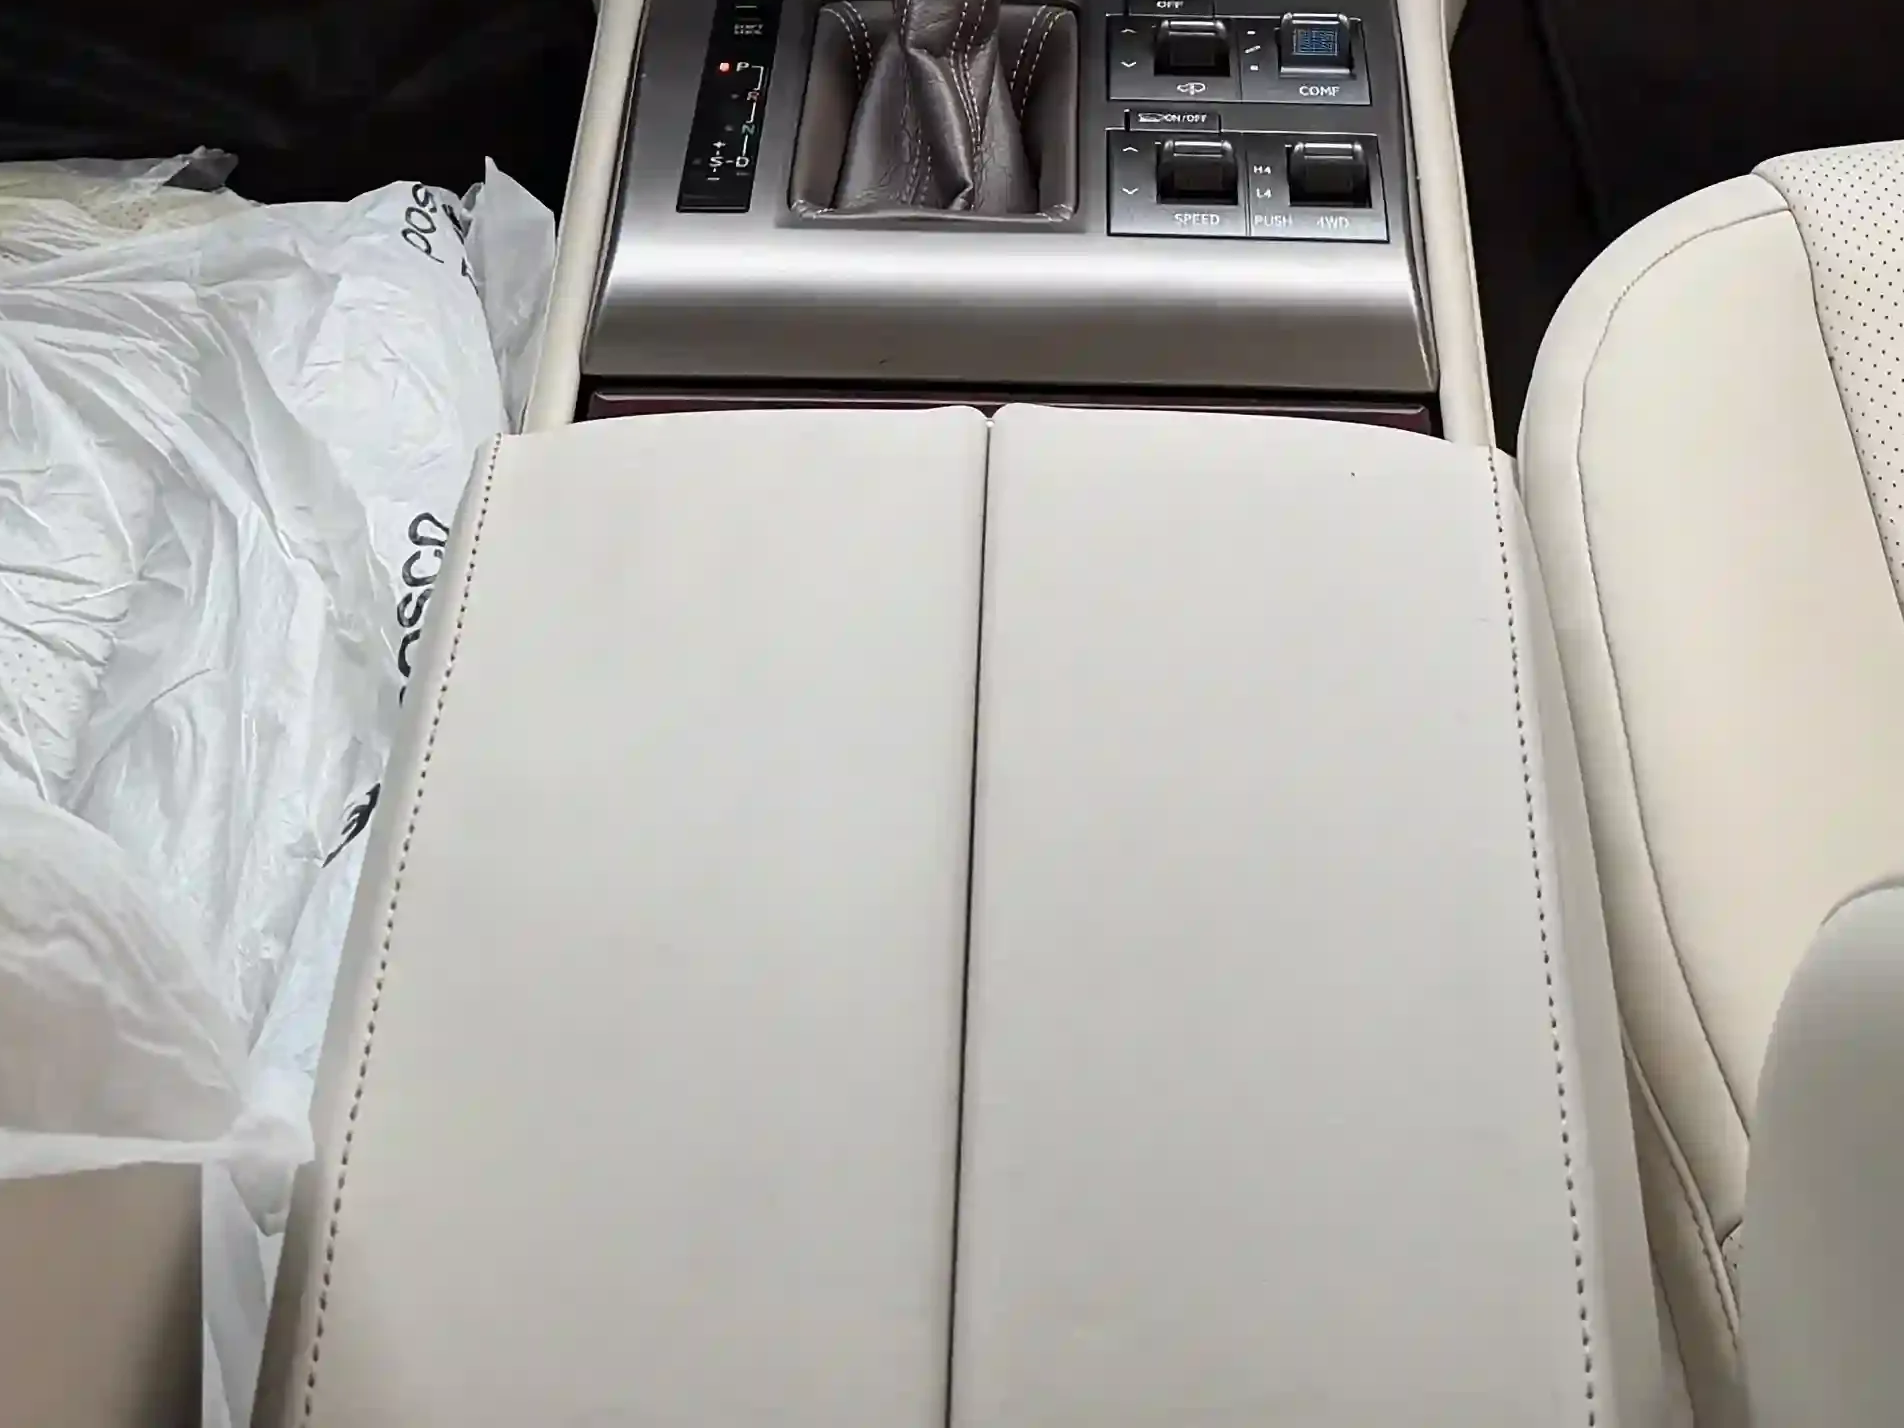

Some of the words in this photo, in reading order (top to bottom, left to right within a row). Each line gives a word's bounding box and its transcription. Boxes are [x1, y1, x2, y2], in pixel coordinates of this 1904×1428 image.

[736, 62, 749, 72] P
[1174, 213, 1220, 226] SPEED
[1254, 215, 1293, 227] PUSH
